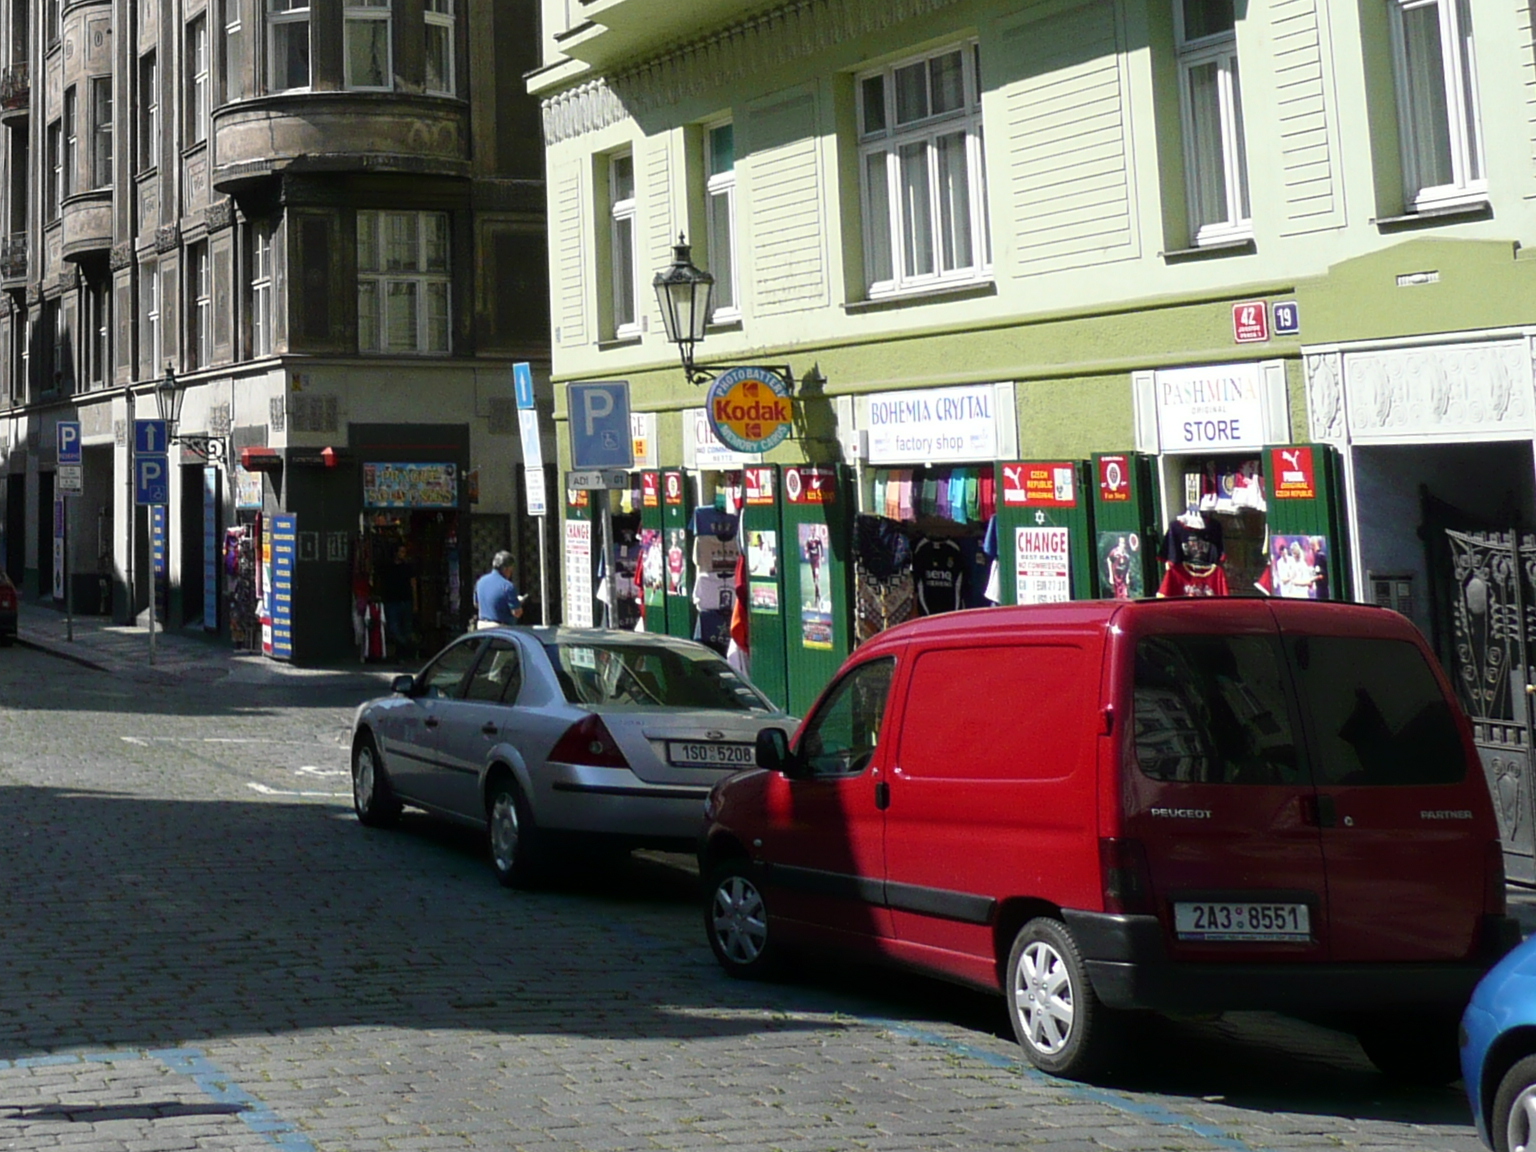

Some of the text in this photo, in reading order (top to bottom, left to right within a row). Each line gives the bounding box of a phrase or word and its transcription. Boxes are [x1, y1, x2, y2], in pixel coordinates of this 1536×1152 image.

[1240, 307, 1257, 325] 42
[1276, 308, 1292, 327] 19
[1163, 377, 1256, 405] PASHMINA
[583, 389, 614, 436] P
[715, 400, 788, 422] Kodak
[871, 394, 991, 425] BOHEMIA CRYSTAL
[61, 426, 77, 451] P
[720, 425, 759, 451] MEMORY
[761, 425, 787, 448] CARDS
[1183, 419, 1241, 442] STORE
[896, 435, 933, 454] factory
[936, 433, 964, 453] shop
[141, 462, 161, 490] P
[1018, 532, 1066, 553] CHANGE
[717, 747, 752, 762] 5208
[1151, 808, 1212, 819] PEUGEOT
[1421, 810, 1473, 820] PARTNER
[1193, 906, 1299, 931] 2A3 8551
